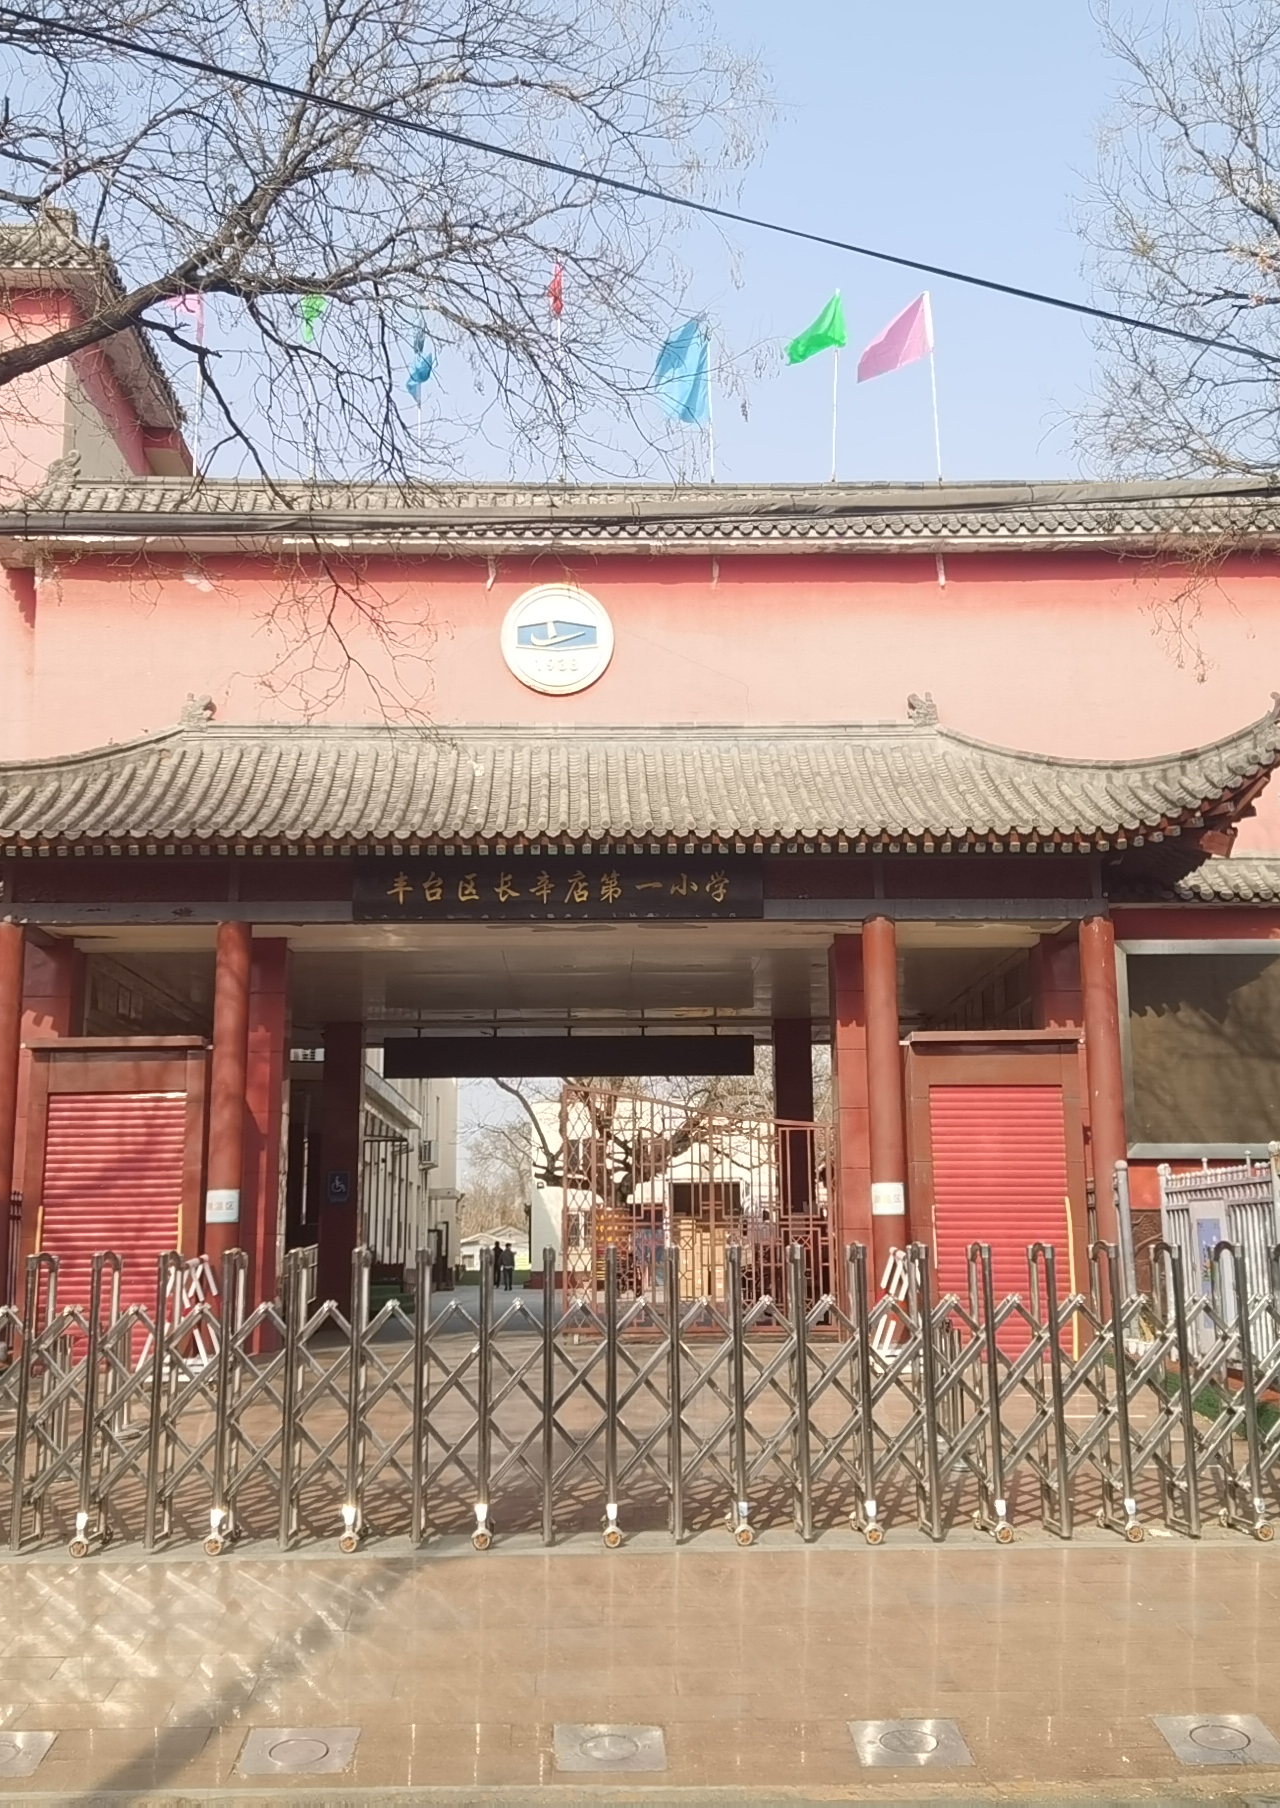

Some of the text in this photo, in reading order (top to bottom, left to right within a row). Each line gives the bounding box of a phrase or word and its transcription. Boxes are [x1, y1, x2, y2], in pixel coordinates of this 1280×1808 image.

[386, 870, 731, 904] 丰台区长辛店第一小学
